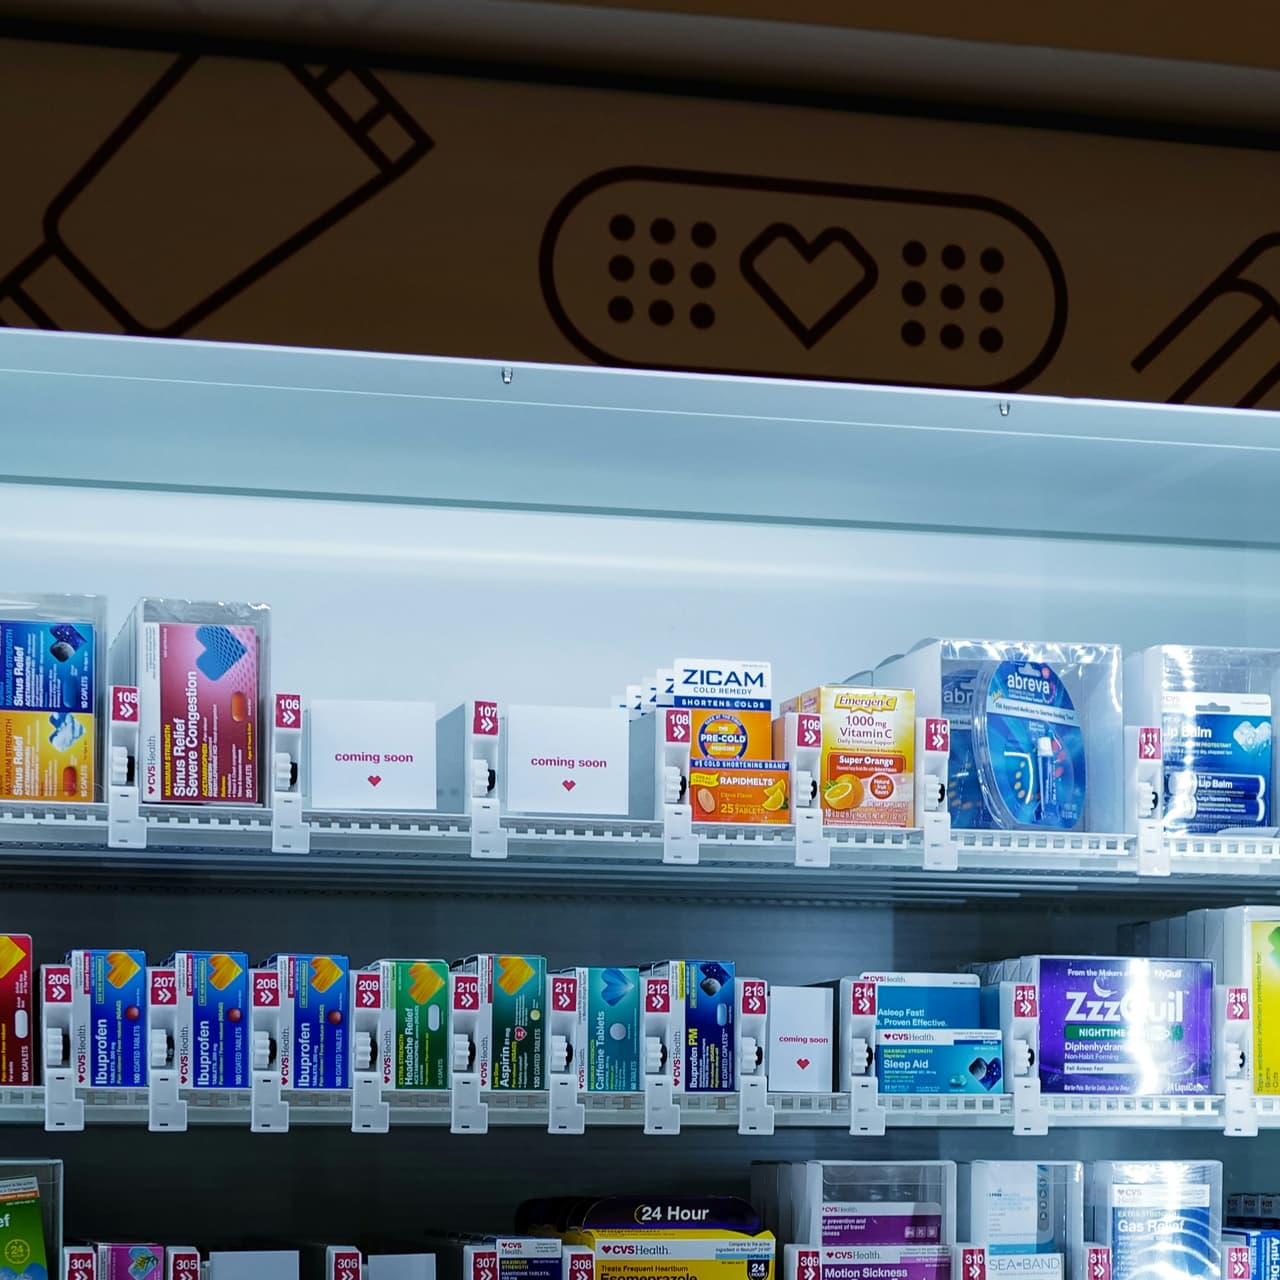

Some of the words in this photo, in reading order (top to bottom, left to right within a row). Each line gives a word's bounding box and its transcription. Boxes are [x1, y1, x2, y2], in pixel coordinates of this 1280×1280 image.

[682, 669, 766, 687] ZICAM
[1007, 675, 1050, 695] abreva
[279, 699, 300, 711] 106
[682, 699, 728, 707] SHORTENS
[731, 700, 765, 708] COLDS
[187, 671, 199, 750] Congestion
[670, 715, 689, 726] 108
[174, 718, 186, 752] Relief
[840, 727, 878, 738] Vitamin
[881, 729, 892, 738] C
[335, 752, 380, 764] coming
[384, 753, 414, 762] soon
[839, 755, 861, 765] Super
[863, 756, 894, 767] Orange
[174, 755, 186, 797] Sinus
[187, 754, 199, 797] Severe
[720, 776, 773, 787] RAPIDMELTS
[1199, 779, 1210, 789] Lip
[1211, 780, 1232, 789] Balm
[720, 803, 733, 814] 25
[735, 805, 768, 815] TABLETS
[359, 980, 379, 991] 209
[648, 984, 668, 994] 212
[1016, 989, 1034, 1000] 215
[878, 1008, 904, 1018] Asleep
[906, 1009, 924, 1017] Fast!
[404, 1008, 413, 1038] Relief
[912, 1019, 948, 1027] Effective.
[1078, 1028, 1125, 1038] NIGHTTIME
[404, 1041, 413, 1085] Headache
[884, 1059, 909, 1071] Sleep
[911, 1060, 928, 1068] Aid
[642, 1206, 661, 1220] 24
[668, 1206, 709, 1220] Hour
[338, 1259, 357, 1268] 306
[965, 1254, 983, 1264] 310
[825, 1268, 862, 1278] Motion
[865, 1268, 907, 1278] Sickness
